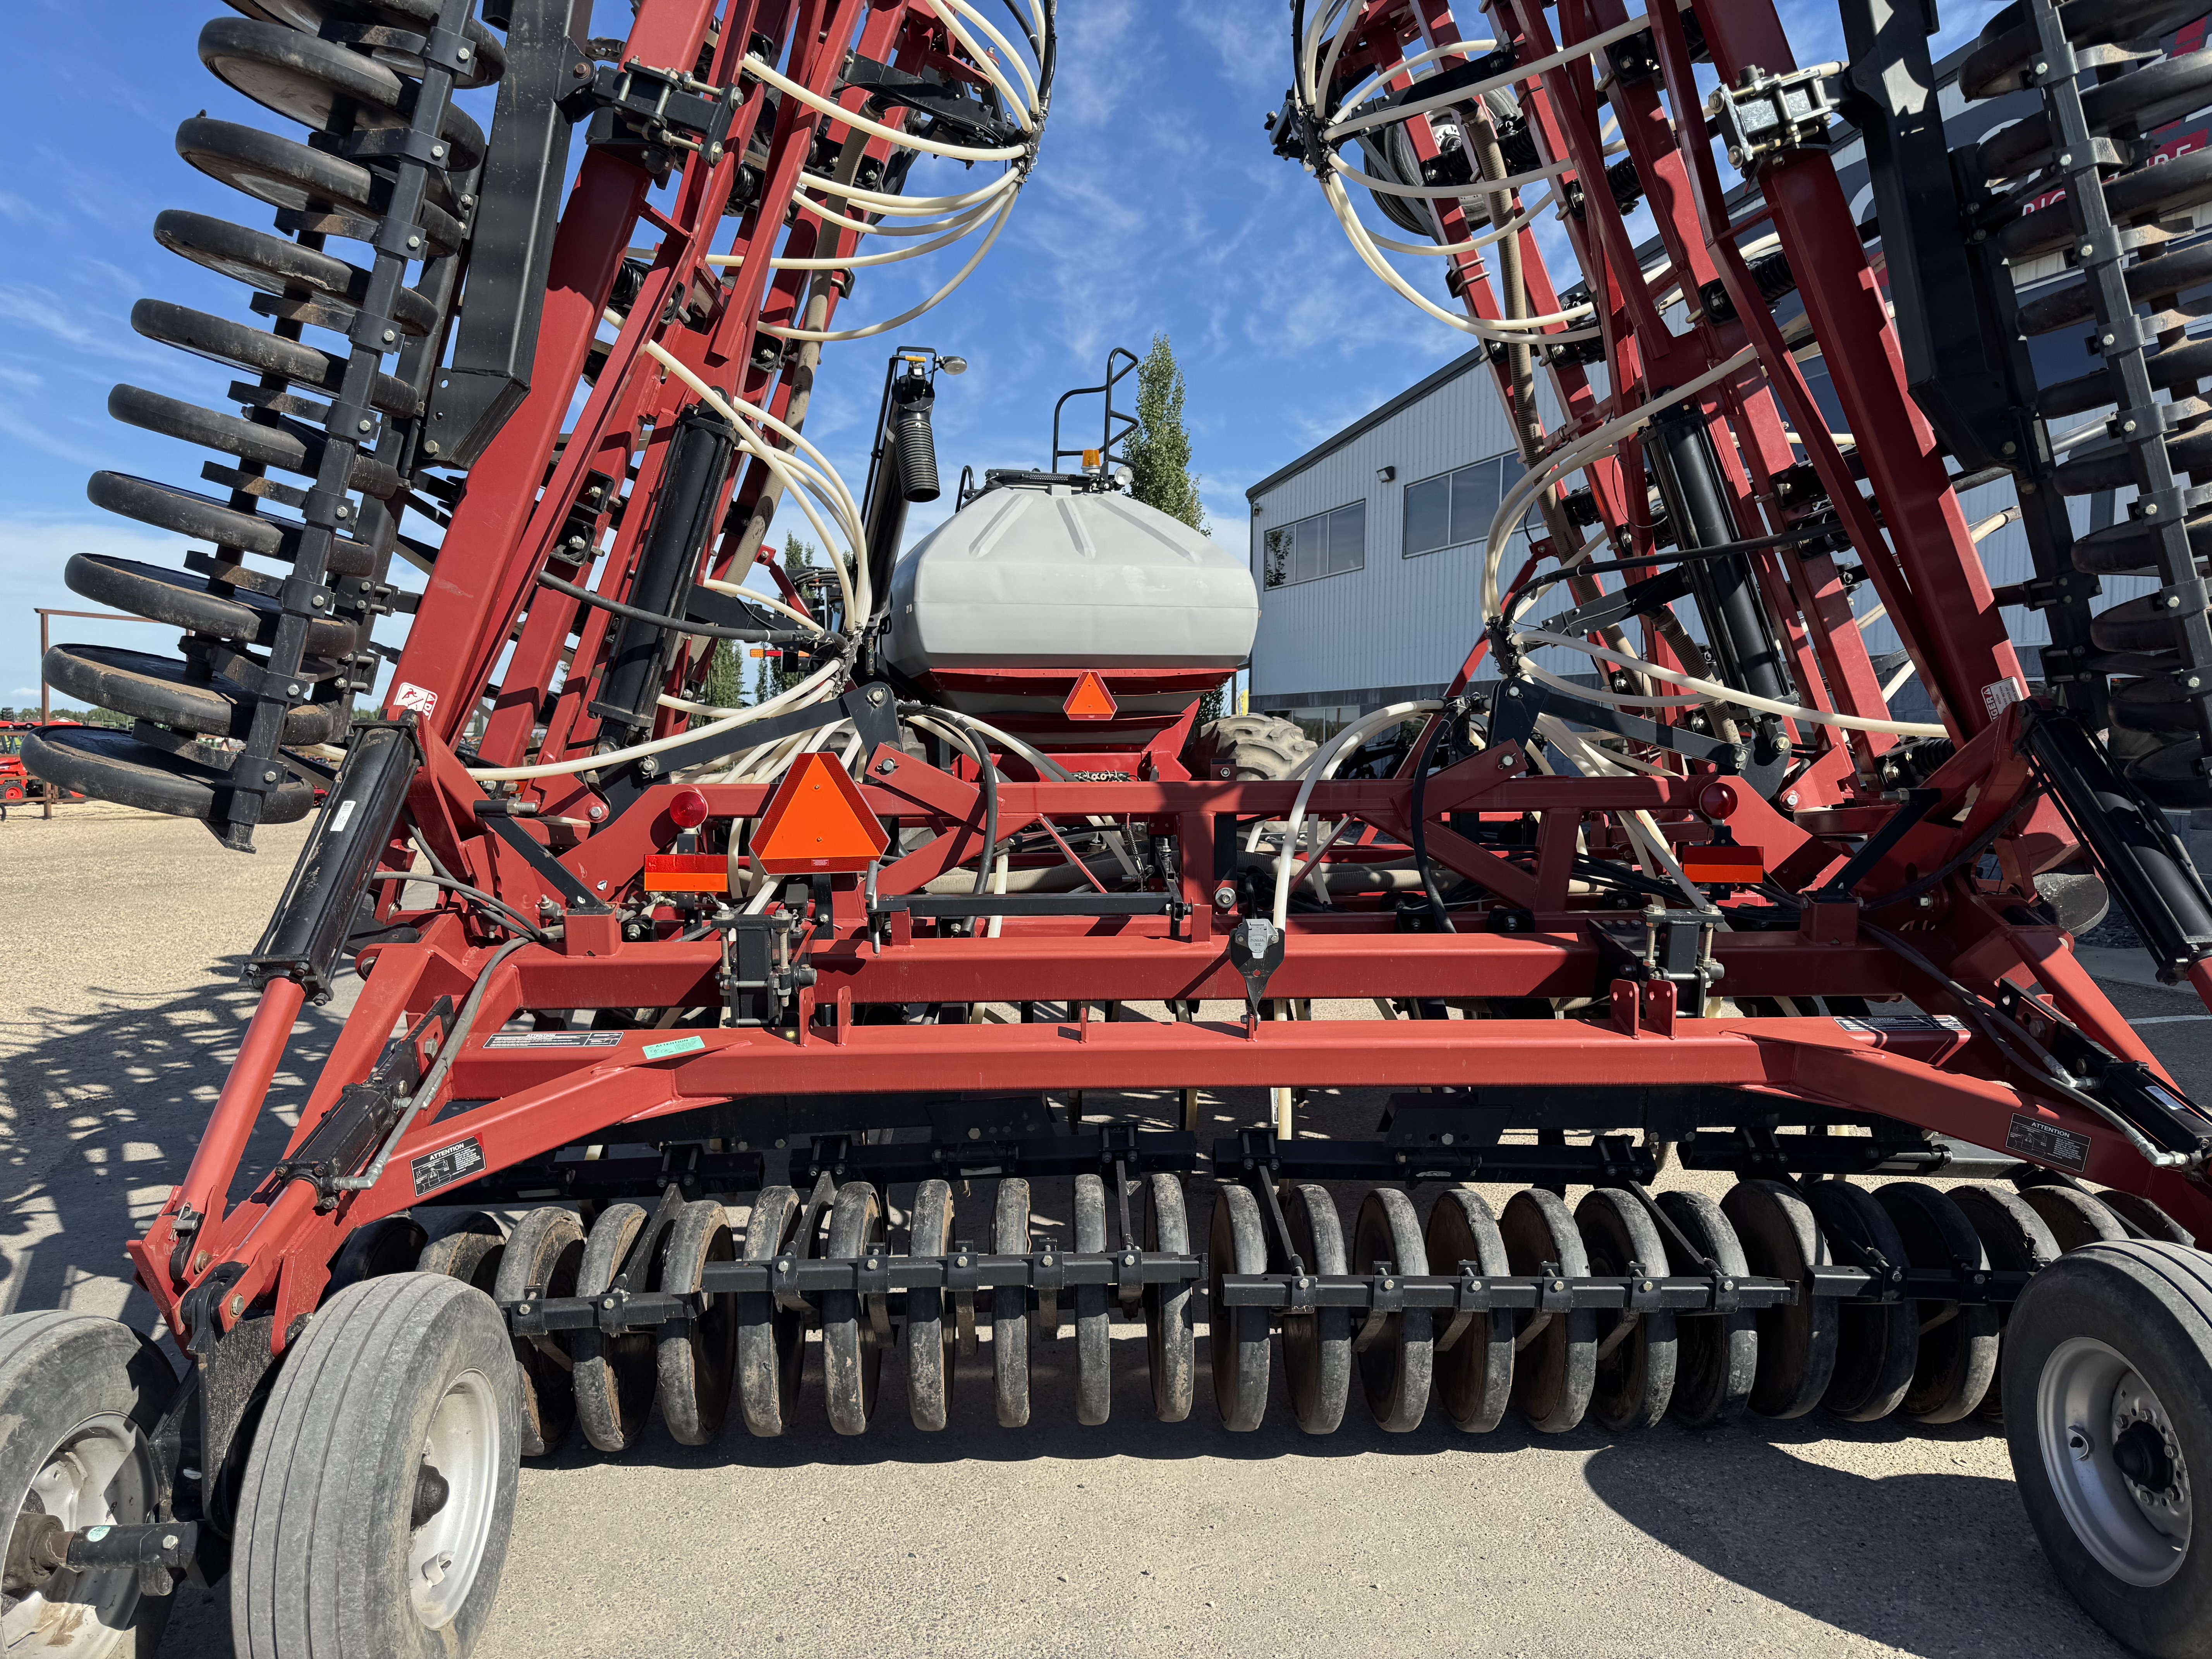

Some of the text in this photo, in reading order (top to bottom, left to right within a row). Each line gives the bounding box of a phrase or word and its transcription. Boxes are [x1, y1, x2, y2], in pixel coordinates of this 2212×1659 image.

[656, 1039, 689, 1048] ATTENTION
[2032, 1122, 2070, 1138] ATTENTION
[430, 1143, 464, 1161] ATTENTION
